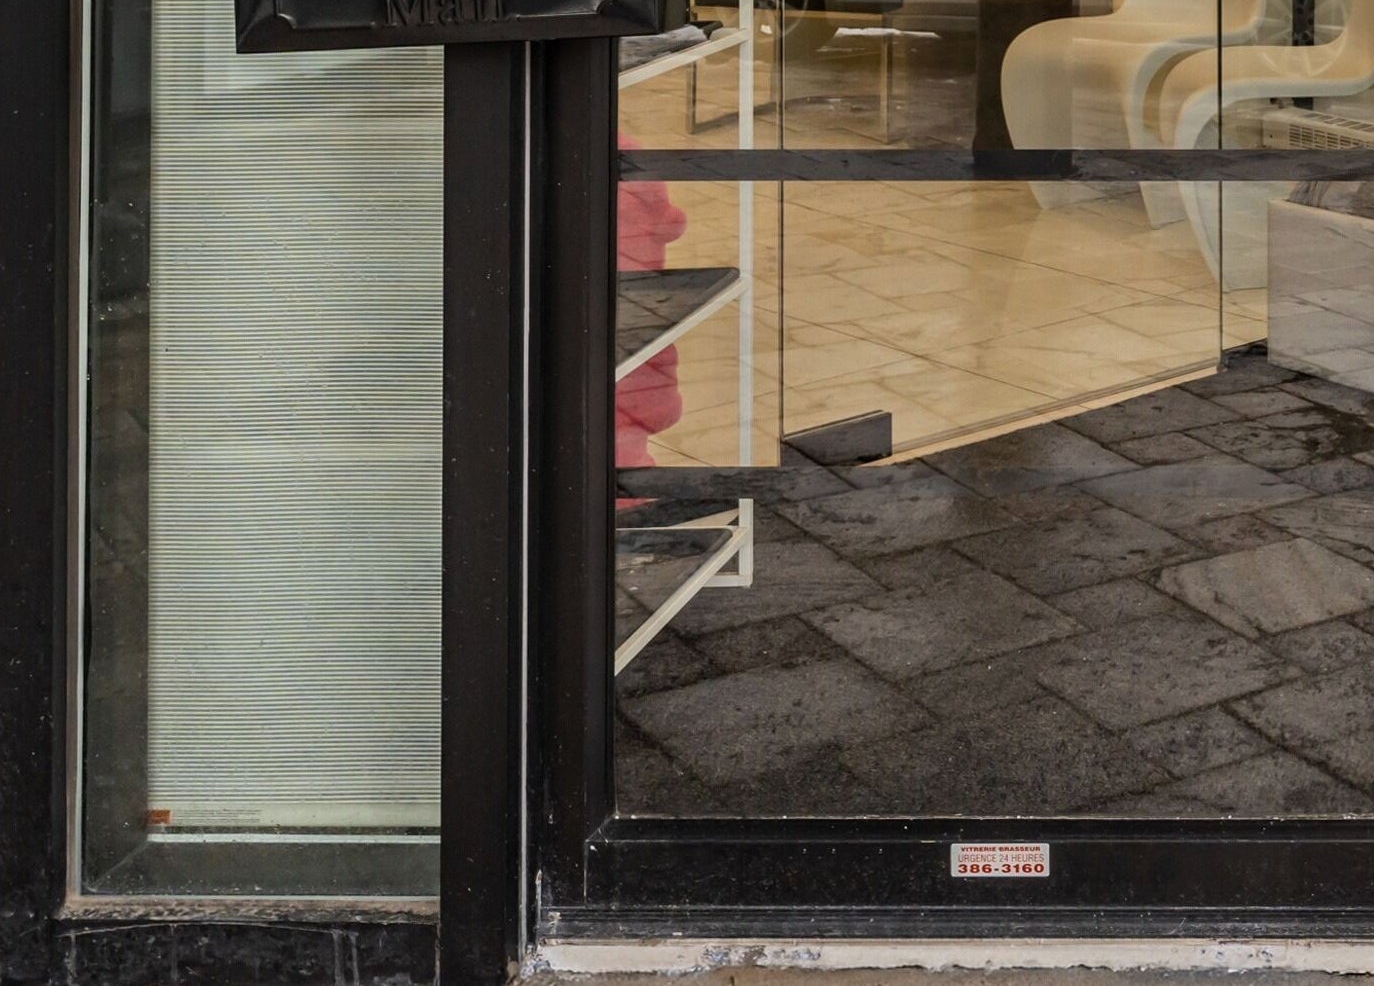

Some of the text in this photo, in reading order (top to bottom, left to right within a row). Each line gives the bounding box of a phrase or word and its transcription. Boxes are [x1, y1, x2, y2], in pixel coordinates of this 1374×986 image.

[958, 854, 1045, 863] URGENCE 24 HEURES
[958, 864, 1045, 874] 386-3160
